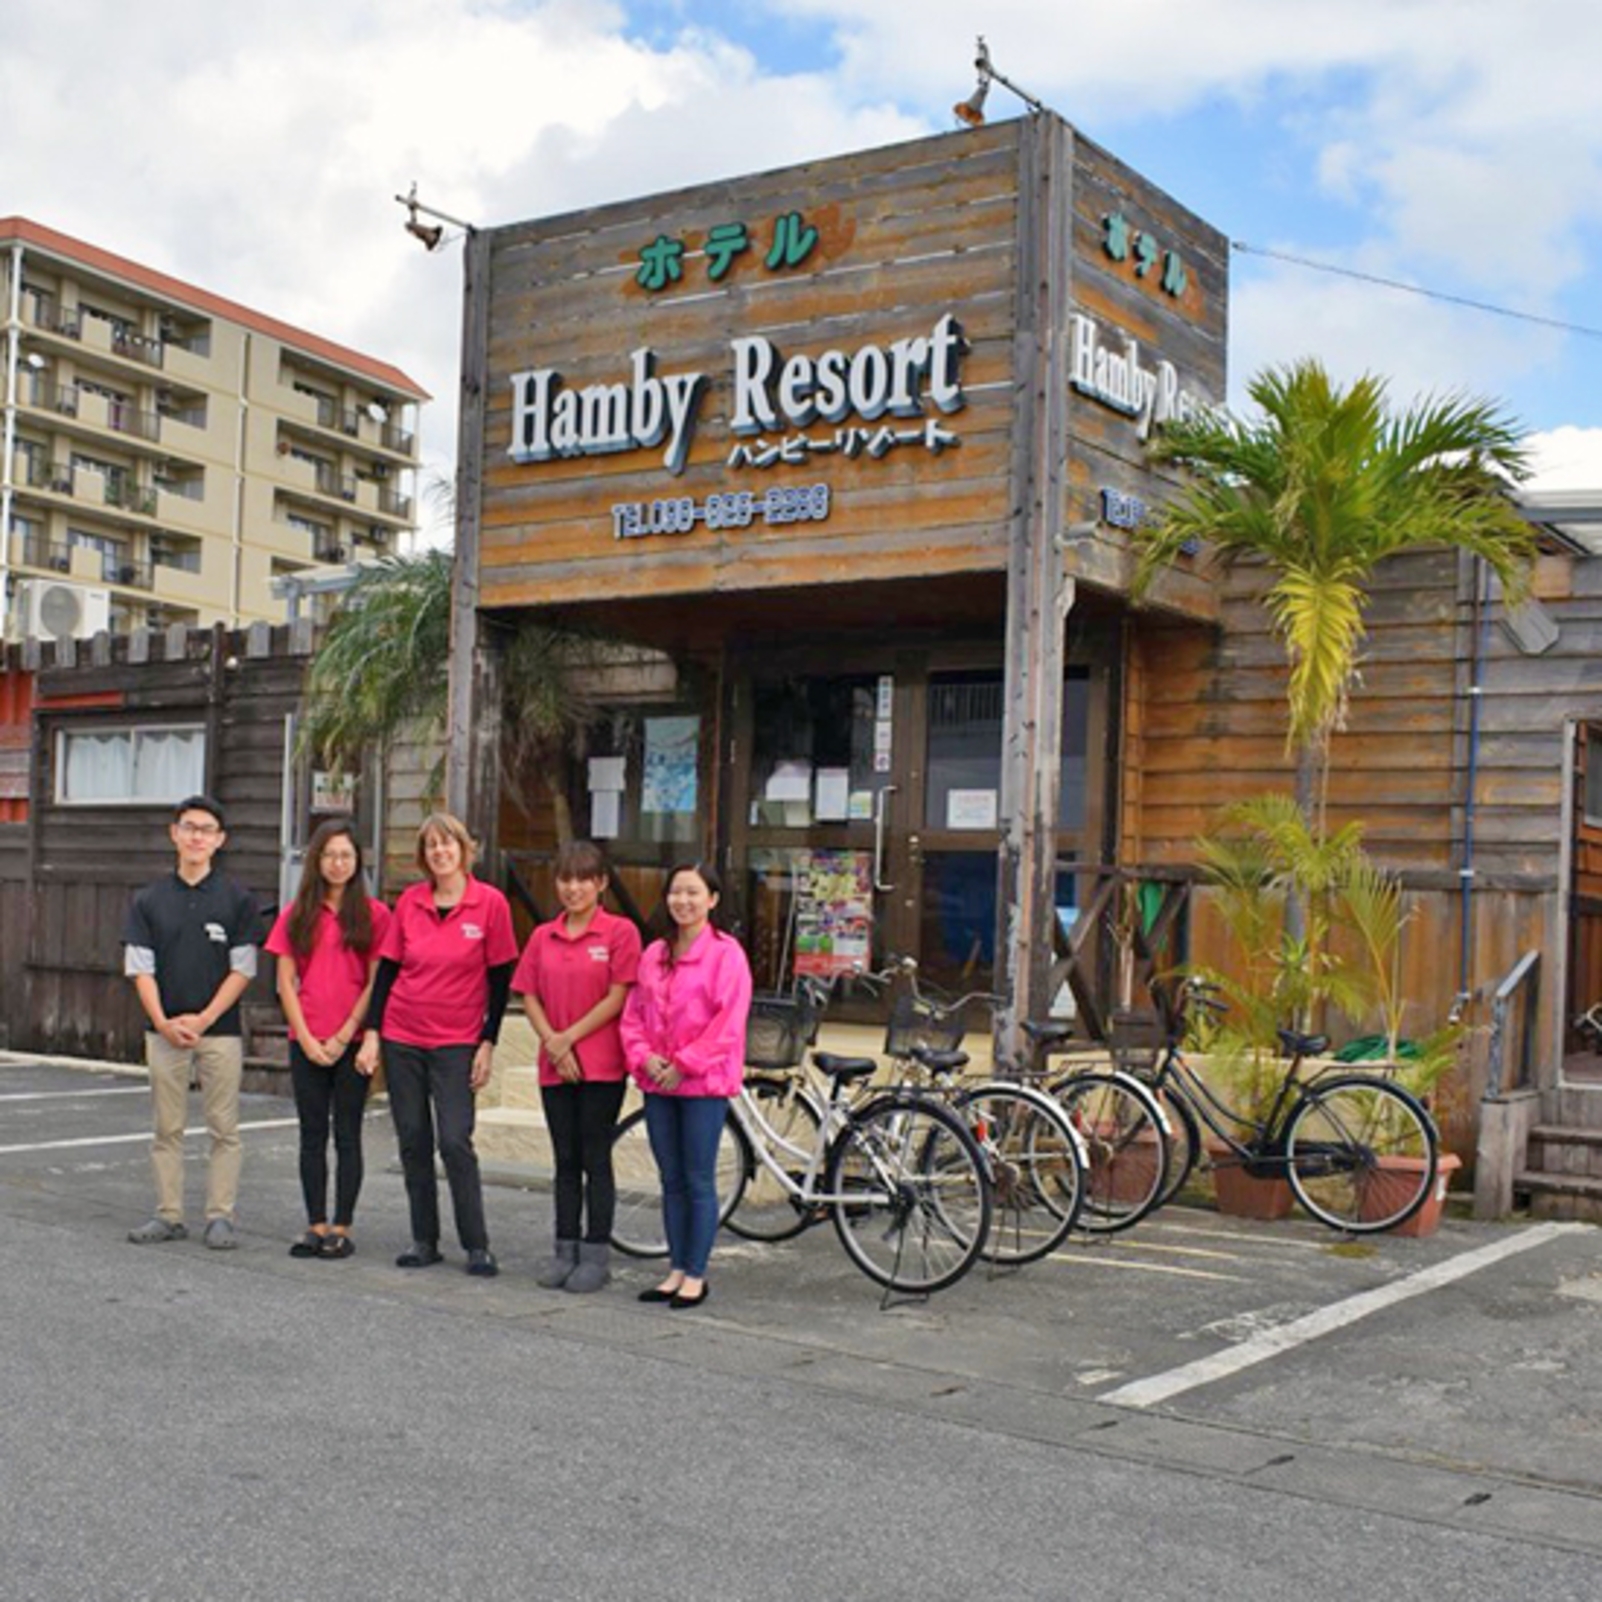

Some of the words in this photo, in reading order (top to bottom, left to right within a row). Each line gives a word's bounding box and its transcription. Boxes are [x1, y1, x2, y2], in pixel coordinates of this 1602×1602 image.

[635, 209, 819, 292] ホテル
[507, 347, 704, 472] Hamby
[729, 313, 960, 433] Resort
[1068, 313, 1157, 442] Hamby
